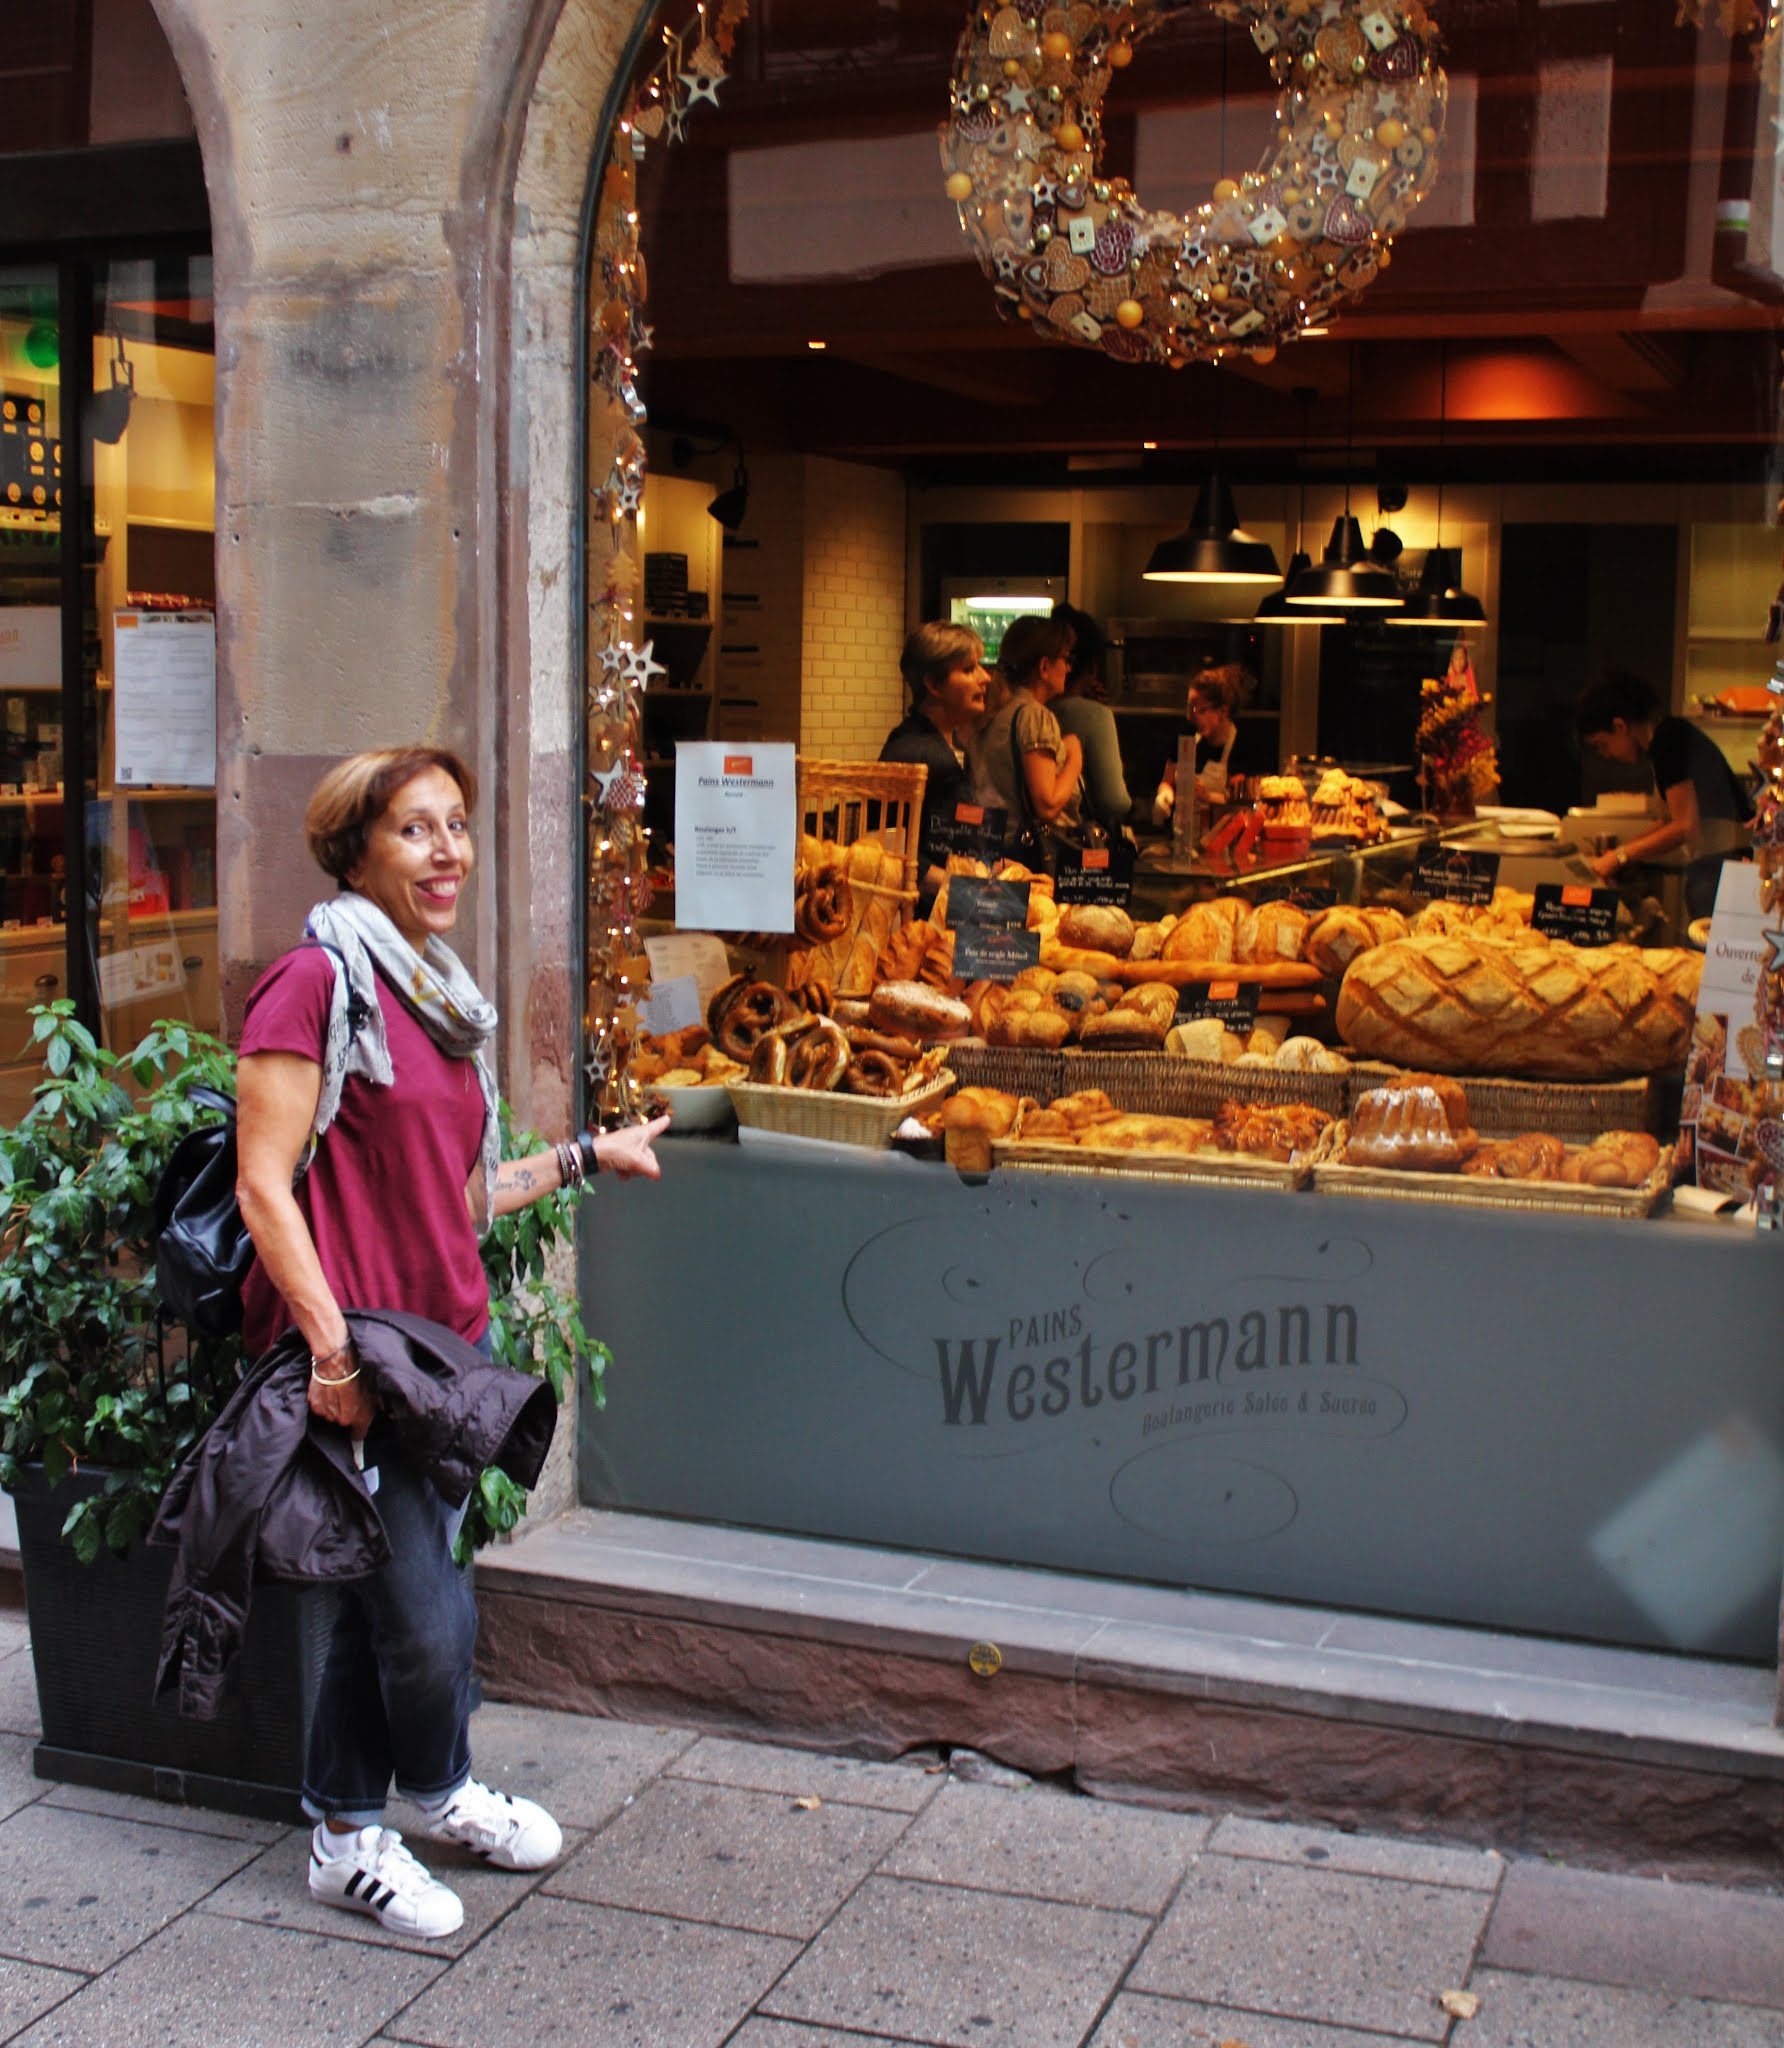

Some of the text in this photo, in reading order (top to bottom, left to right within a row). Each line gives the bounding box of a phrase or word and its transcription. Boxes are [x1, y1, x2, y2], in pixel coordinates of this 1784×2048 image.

[698, 776, 775, 788] Pains Westermann
[1008, 1303, 1082, 1351] PAINS
[934, 1302, 1361, 1426] Westermann
